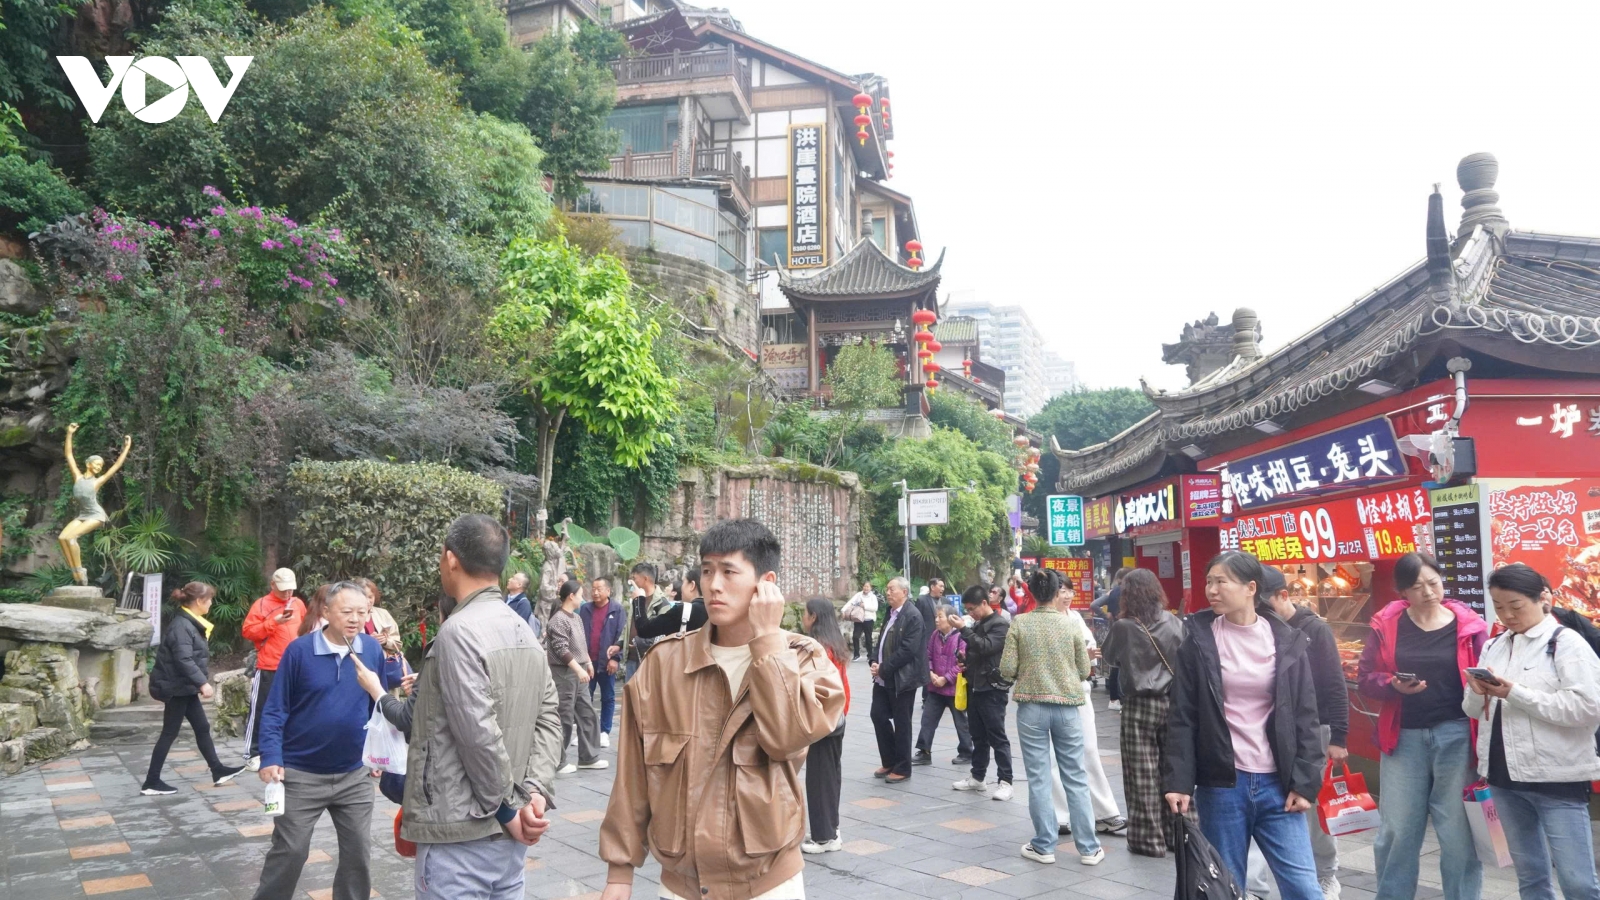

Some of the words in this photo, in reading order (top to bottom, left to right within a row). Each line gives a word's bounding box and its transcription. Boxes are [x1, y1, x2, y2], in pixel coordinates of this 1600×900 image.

[796, 128, 818, 244] 洪崖叠院酒店
[791, 256, 823, 266] HOTEL
[1052, 499, 1079, 512] 夜景
[1489, 490, 1577, 521] 坚持做好
[1052, 514, 1080, 527] 游船
[1085, 501, 1109, 530] 售票处
[1053, 529, 1080, 543] 直销
[1045, 560, 1089, 570] 两江游船
